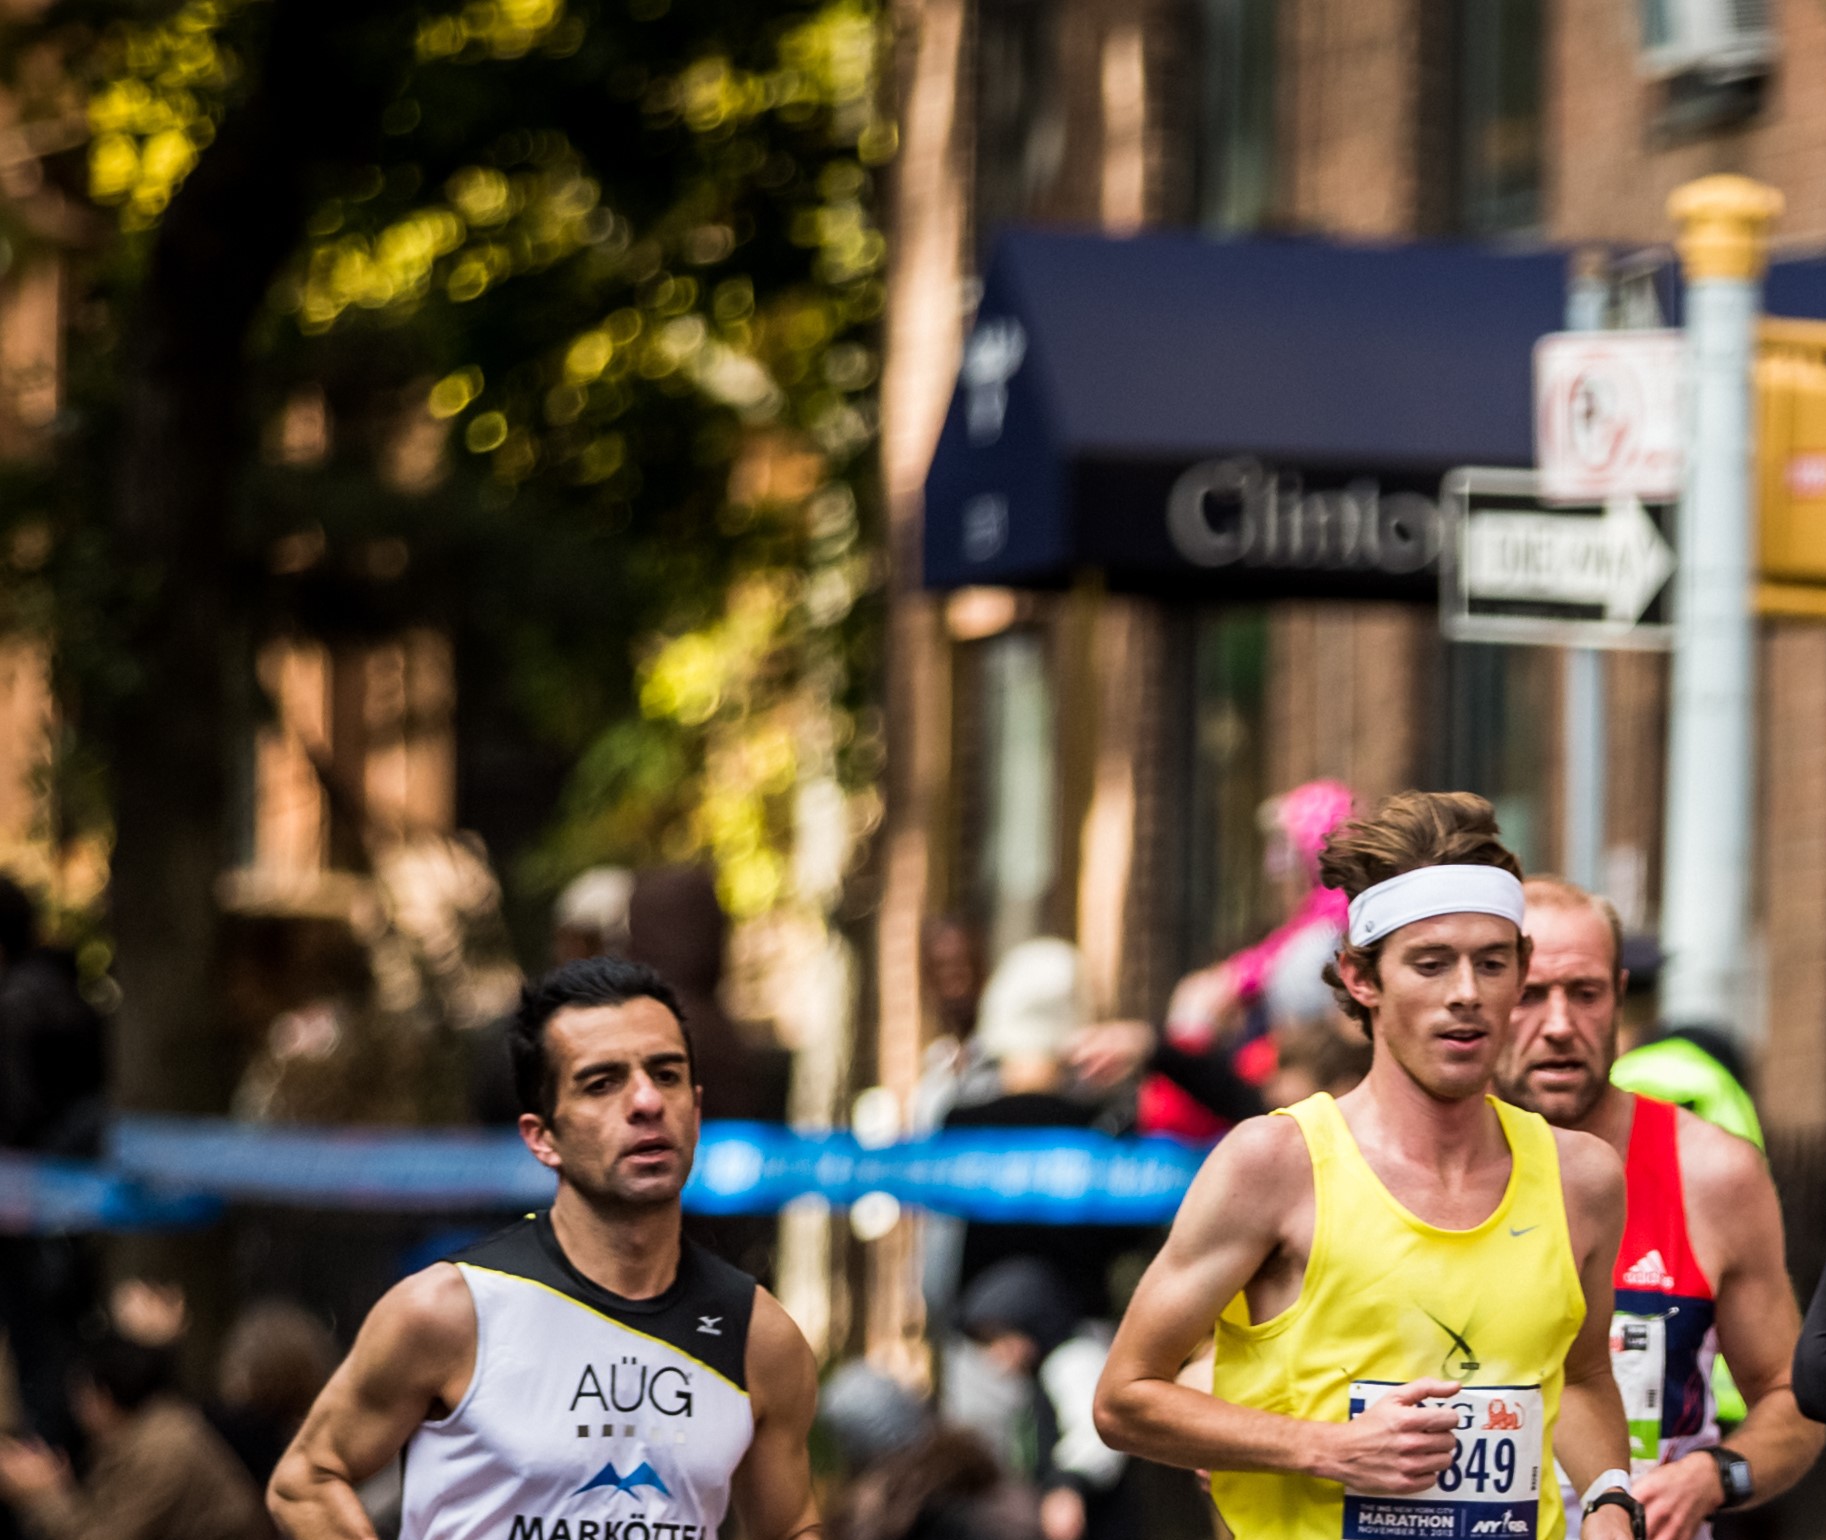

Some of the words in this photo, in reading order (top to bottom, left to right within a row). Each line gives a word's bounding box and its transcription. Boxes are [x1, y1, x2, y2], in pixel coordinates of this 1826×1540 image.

[570, 1356, 692, 1417] AÜG
[1358, 1512, 1454, 1528] MARATHON
[1358, 1526, 1414, 1537] NOVEMBER
